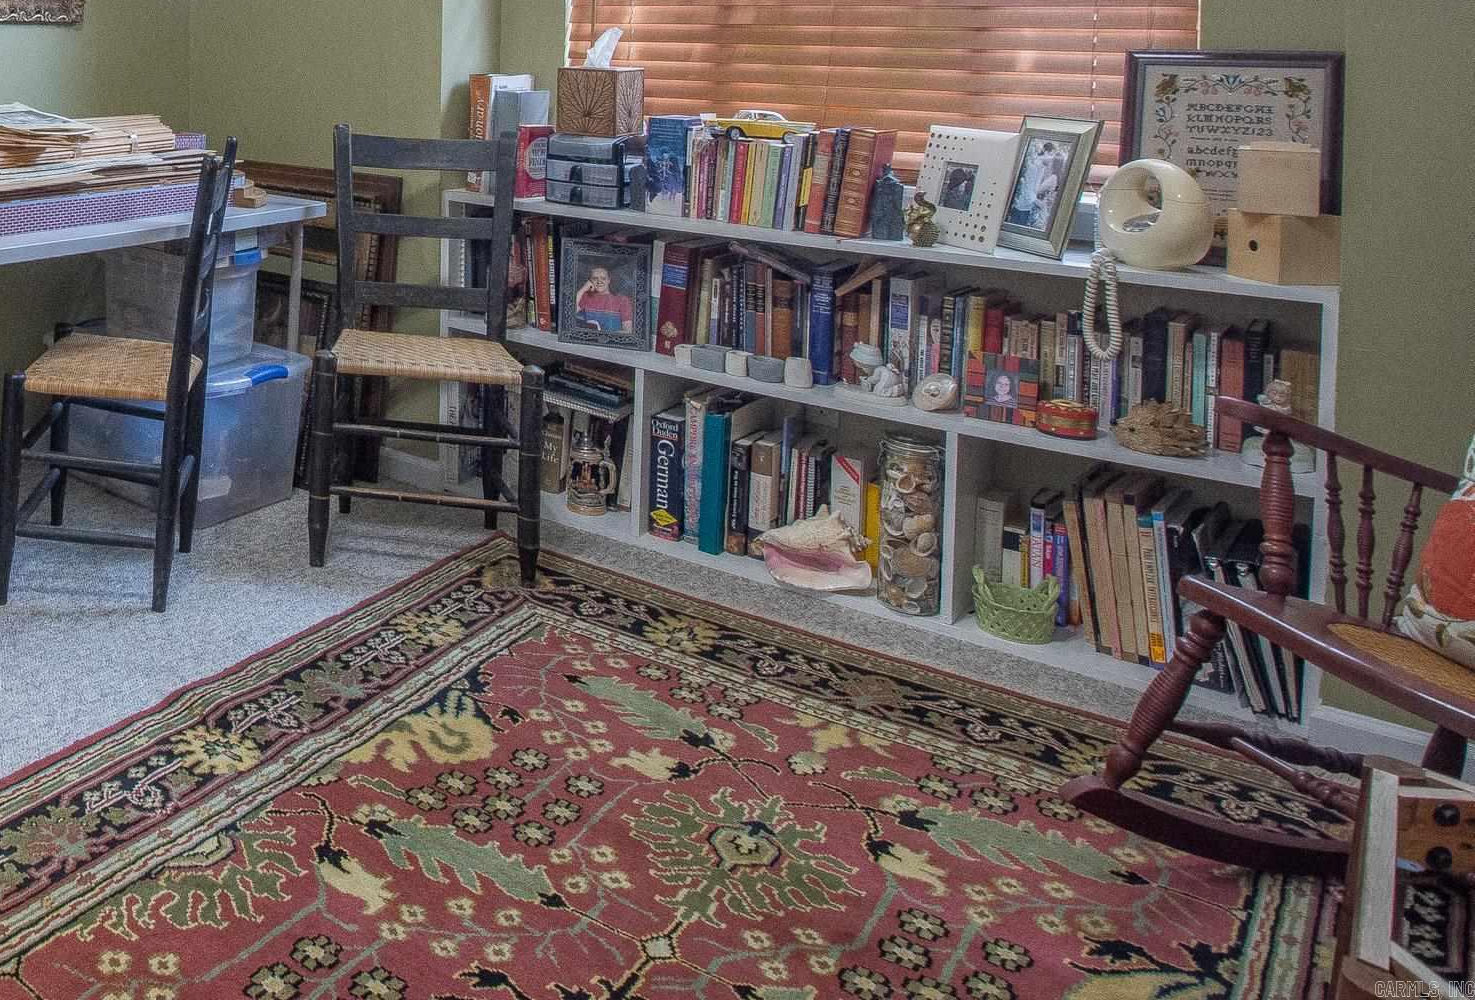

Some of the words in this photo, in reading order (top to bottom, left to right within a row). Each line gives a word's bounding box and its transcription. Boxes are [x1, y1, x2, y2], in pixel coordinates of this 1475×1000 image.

[651, 418, 679, 432] Oxford
[652, 425, 678, 440] Duden
[656, 439, 675, 510] German
[1032, 535, 1042, 569] JAPAN
